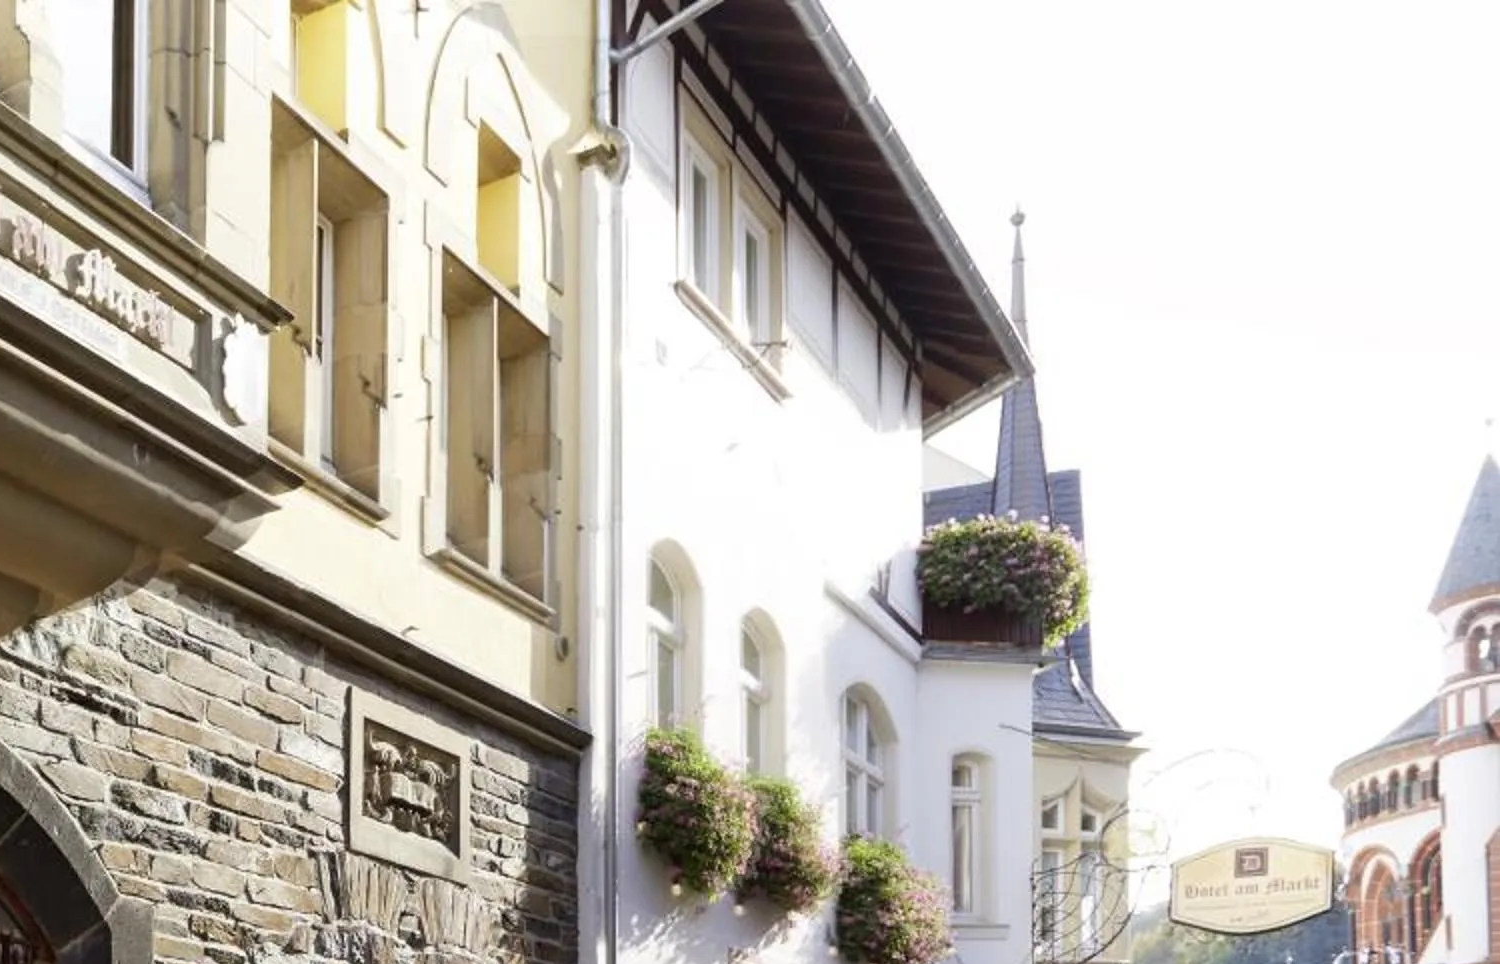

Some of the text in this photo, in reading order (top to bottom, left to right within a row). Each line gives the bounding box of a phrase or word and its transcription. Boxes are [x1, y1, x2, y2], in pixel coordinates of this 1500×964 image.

[1184, 877, 1320, 899] Hotel am Markt
